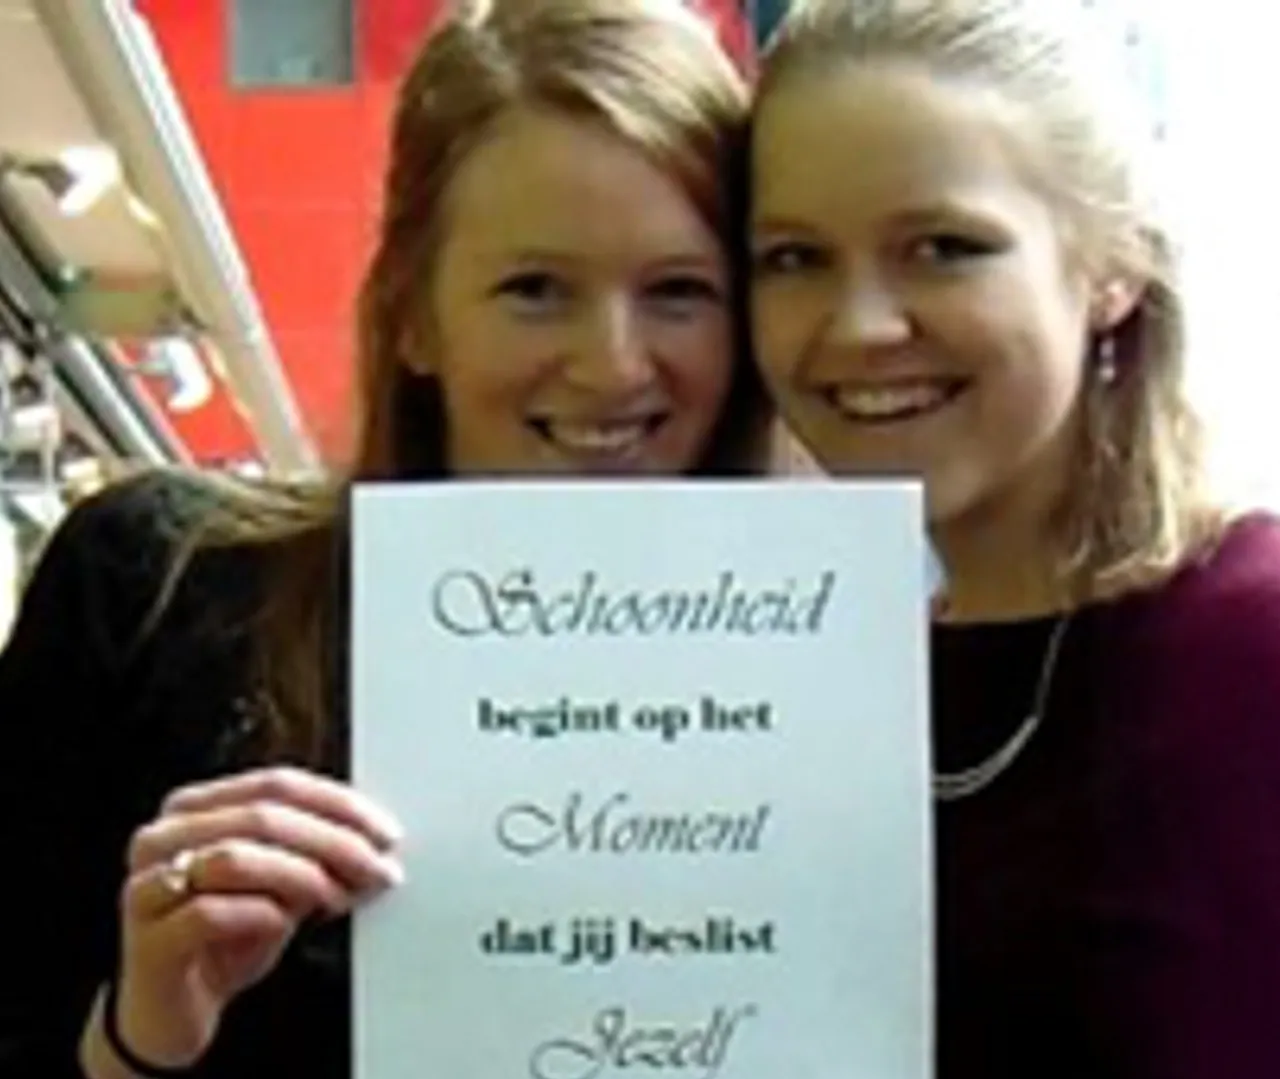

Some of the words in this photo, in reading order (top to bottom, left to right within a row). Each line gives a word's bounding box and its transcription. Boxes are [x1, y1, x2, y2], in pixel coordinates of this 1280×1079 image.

[431, 568, 836, 638] Schoonheid
[477, 696, 621, 740] begint
[631, 705, 691, 744] op
[699, 696, 773, 733] het
[495, 791, 771, 857] Moment
[478, 917, 557, 955] dat
[560, 916, 617, 966] jij
[628, 916, 776, 955] beslist
